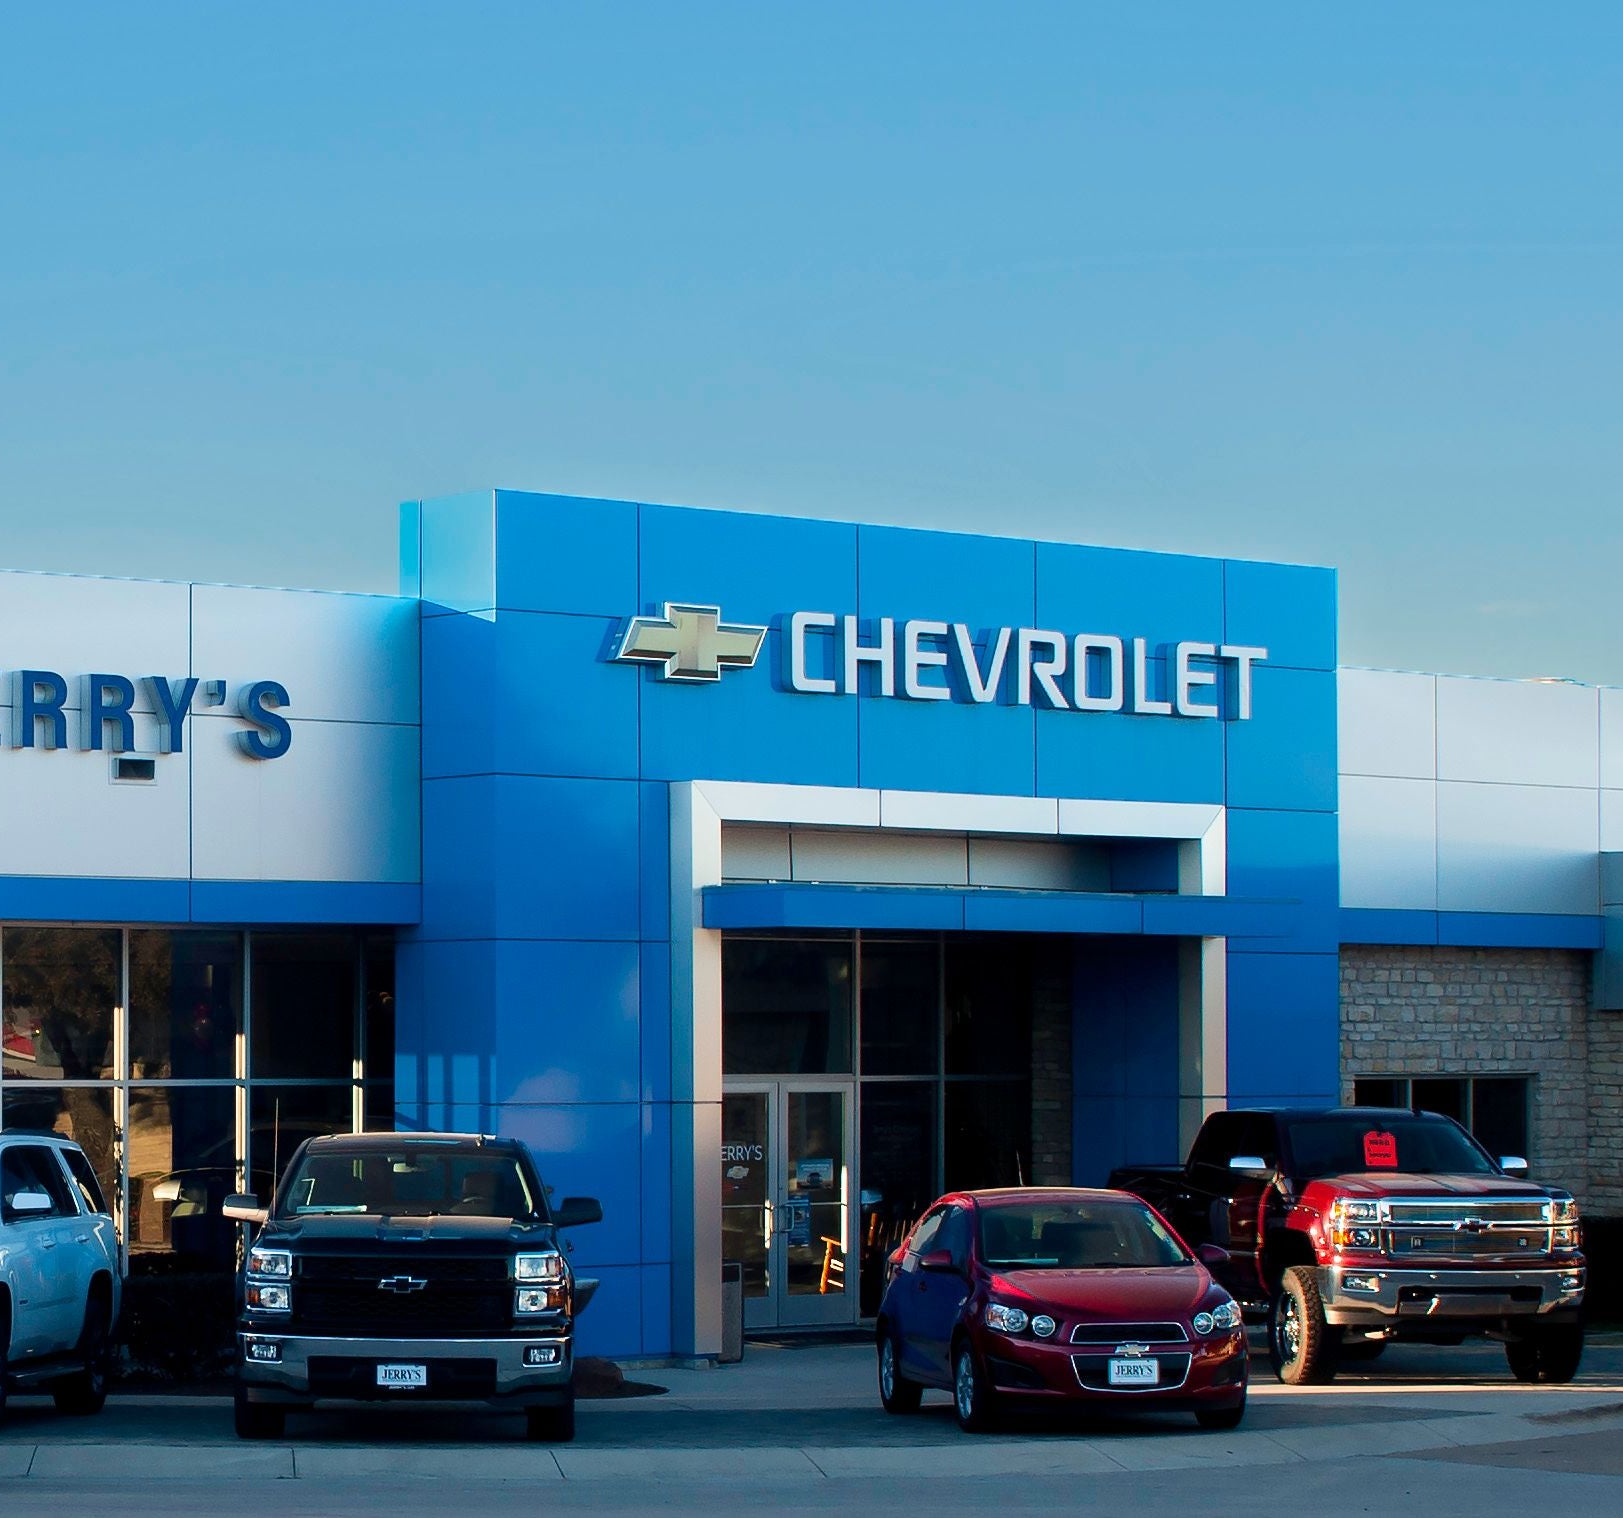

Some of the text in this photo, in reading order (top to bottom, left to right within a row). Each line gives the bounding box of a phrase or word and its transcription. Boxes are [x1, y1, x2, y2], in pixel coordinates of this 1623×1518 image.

[786, 611, 1268, 721] CHEVROLET
[719, 1144, 763, 1161] ERRY'S
[382, 1368, 422, 1380] JERRY'S
